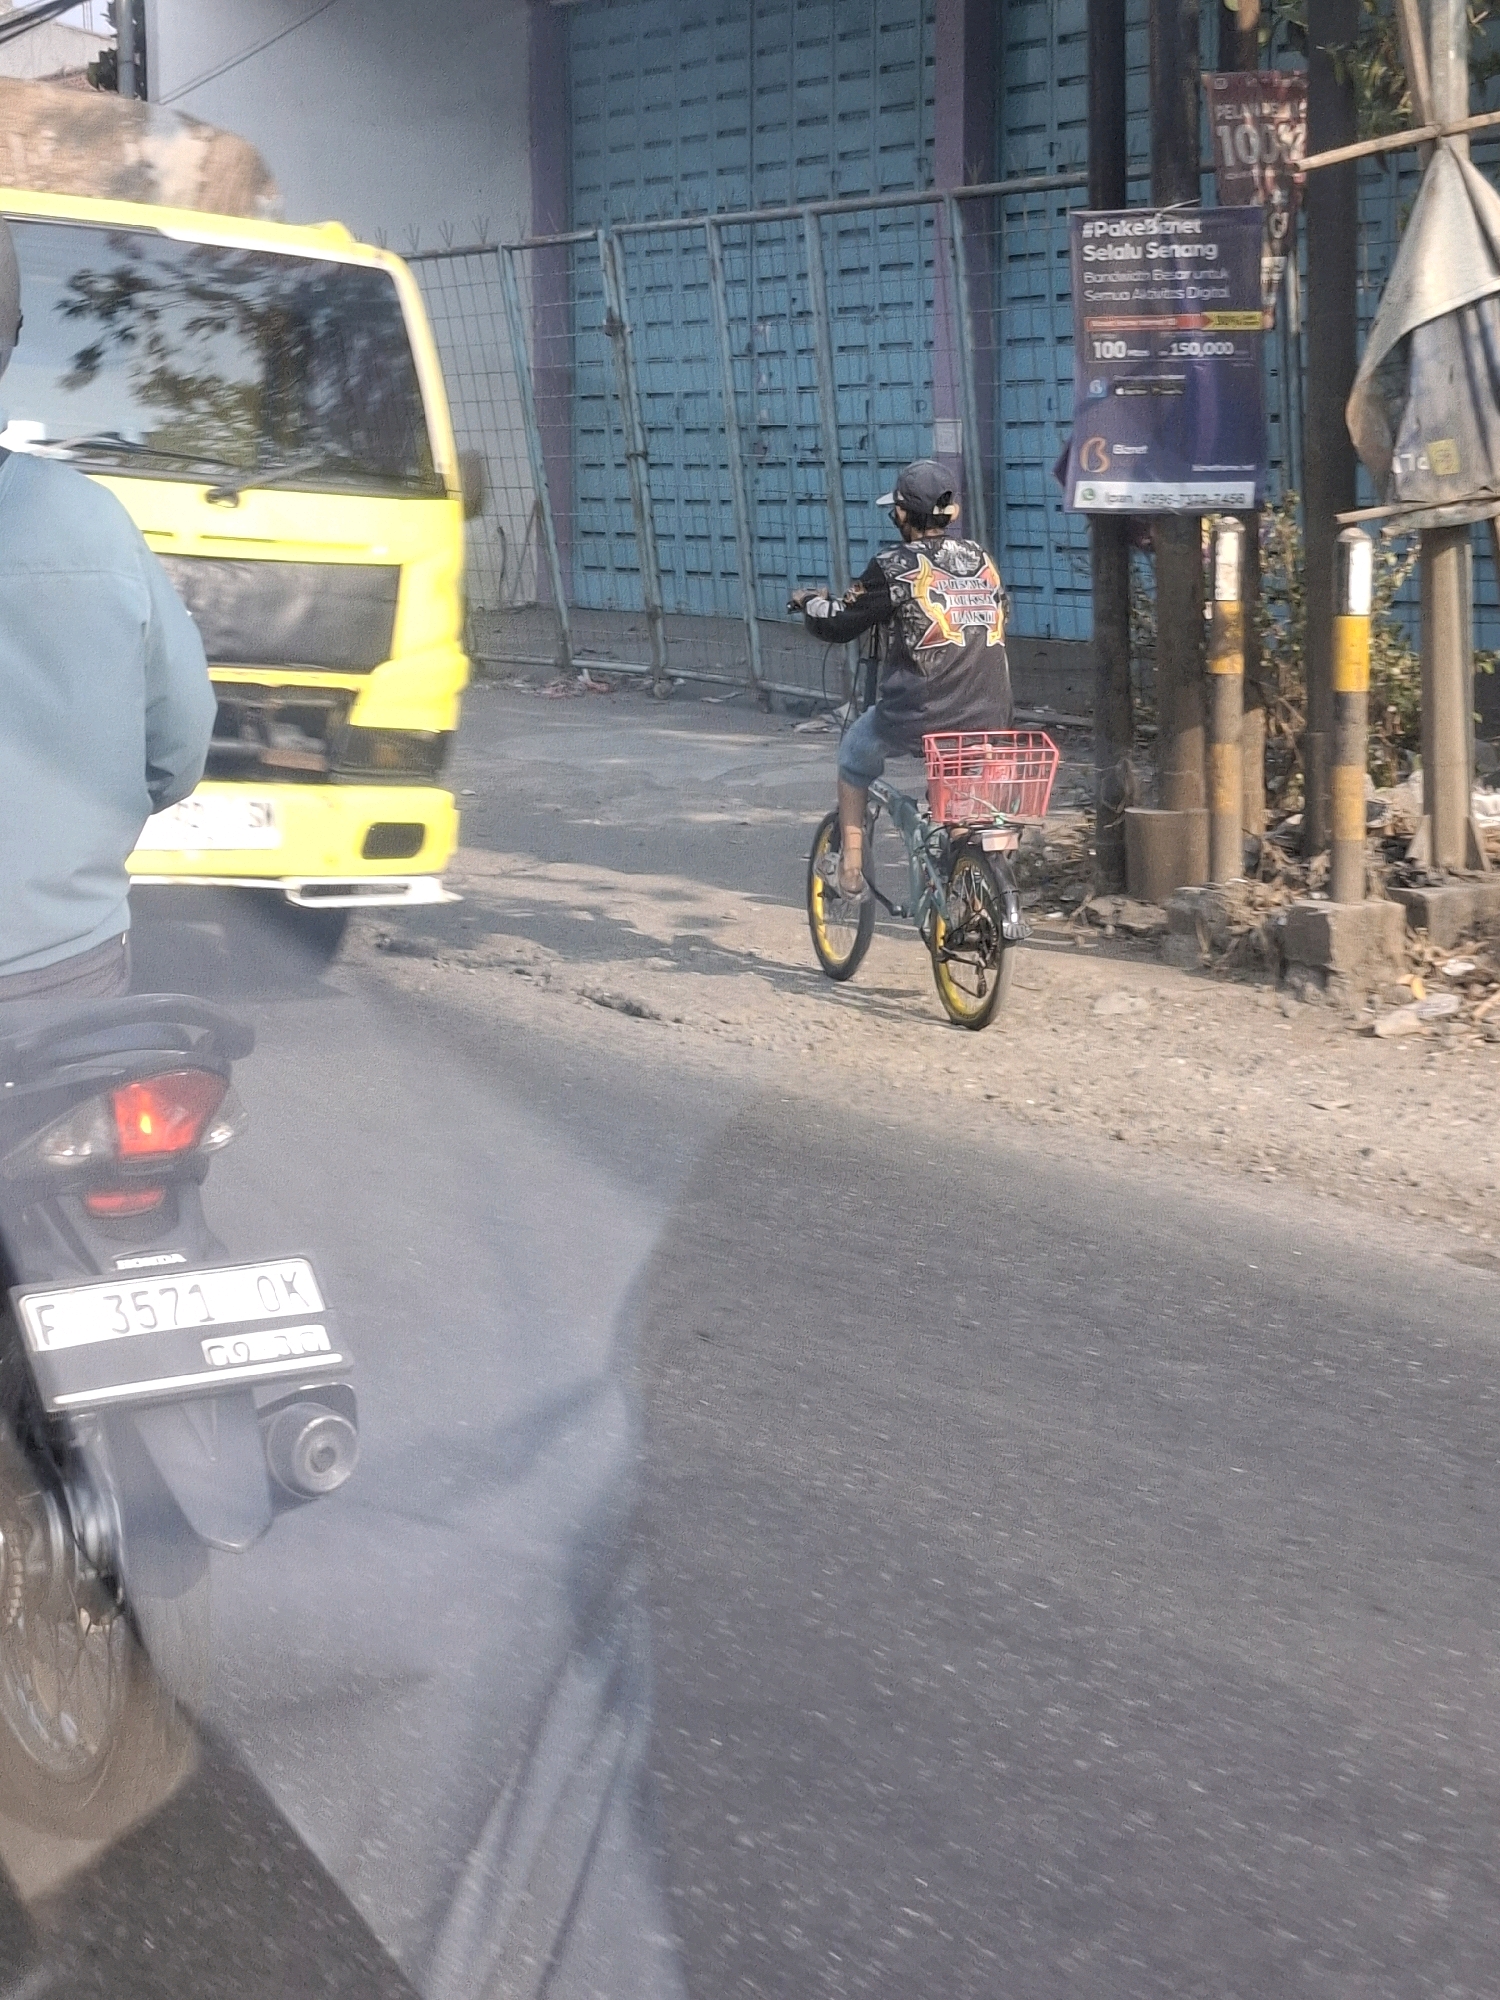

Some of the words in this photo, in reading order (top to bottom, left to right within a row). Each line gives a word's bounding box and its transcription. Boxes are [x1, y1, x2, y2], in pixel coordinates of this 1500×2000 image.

[1082, 243, 1143, 261] Selalu
[1145, 242, 1219, 260] Senang
[1083, 289, 1131, 302] Semua
[1092, 340, 1127, 359] 100
[103, 1284, 216, 1335] 3571
[256, 1271, 311, 1312] OK
